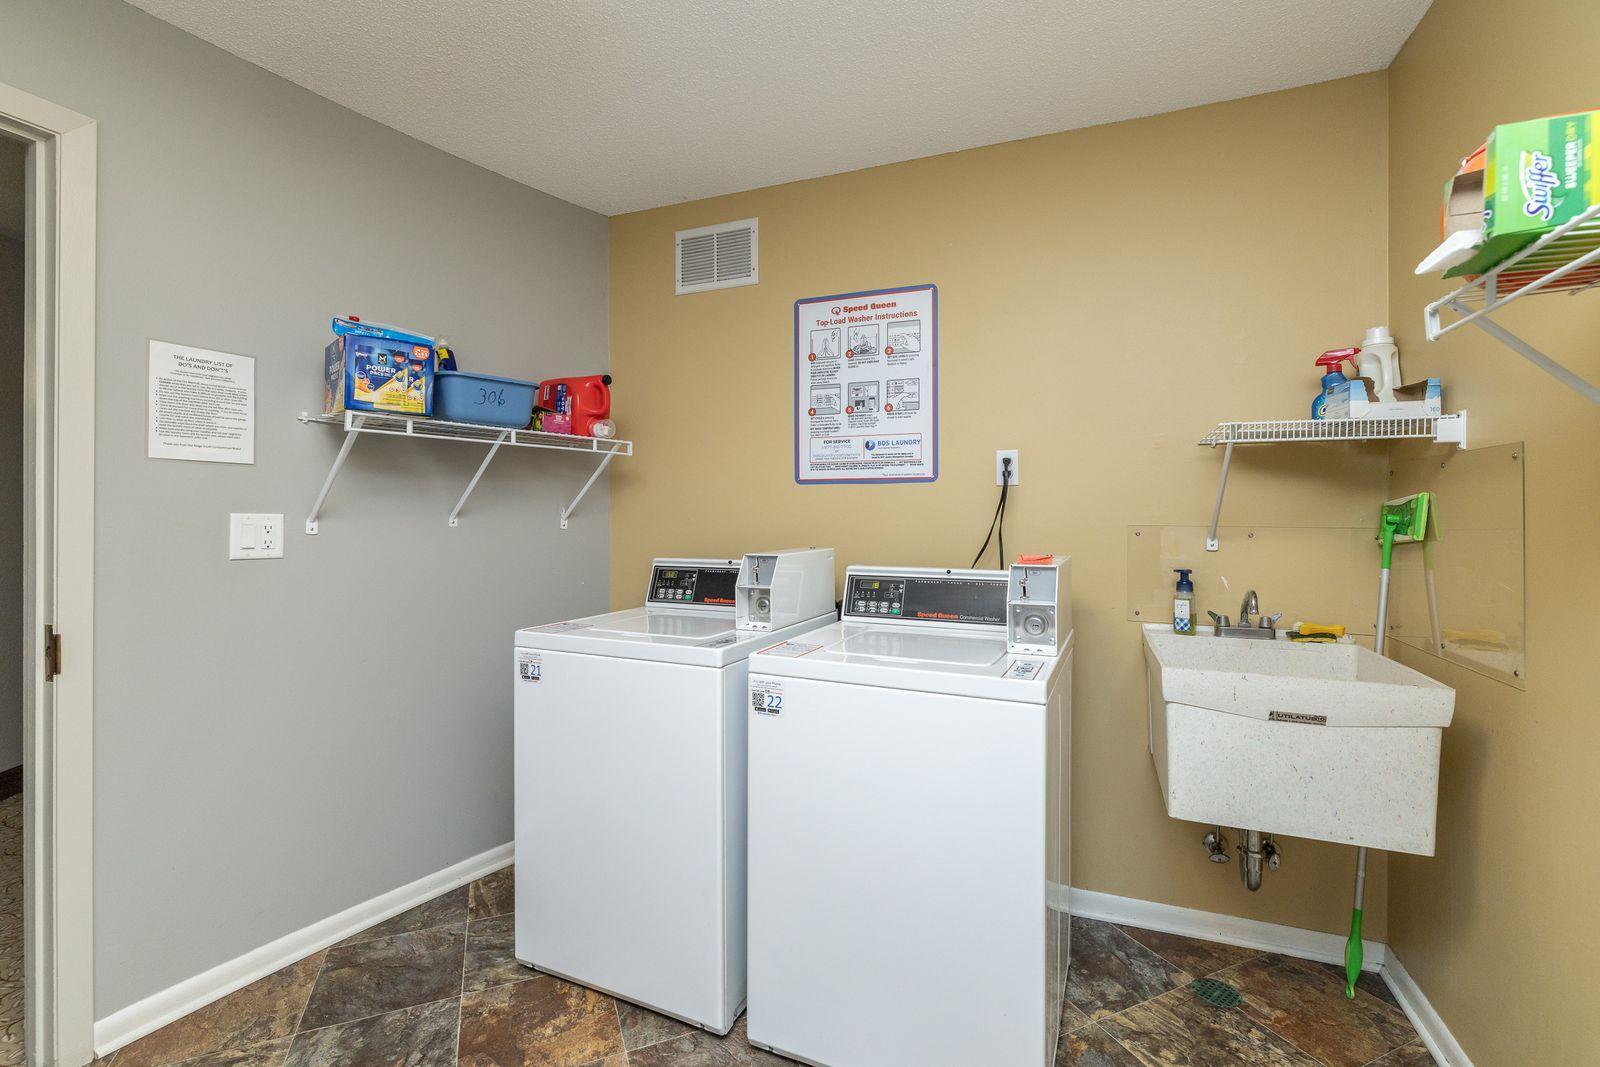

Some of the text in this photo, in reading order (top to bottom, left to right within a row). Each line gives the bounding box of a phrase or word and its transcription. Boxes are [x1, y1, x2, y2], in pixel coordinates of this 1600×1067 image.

[1564, 141, 1577, 189] SWEEPER
[1526, 153, 1555, 219] Swiffer
[843, 304, 868, 314] Speed
[870, 301, 897, 310] Queen
[816, 310, 918, 327] Top-Load Washer Instructions
[185, 356, 213, 365] LAUNDRY
[366, 364, 396, 374] POWER
[473, 387, 506, 406] 306
[530, 664, 542, 677] 21
[767, 694, 782, 709] 22
